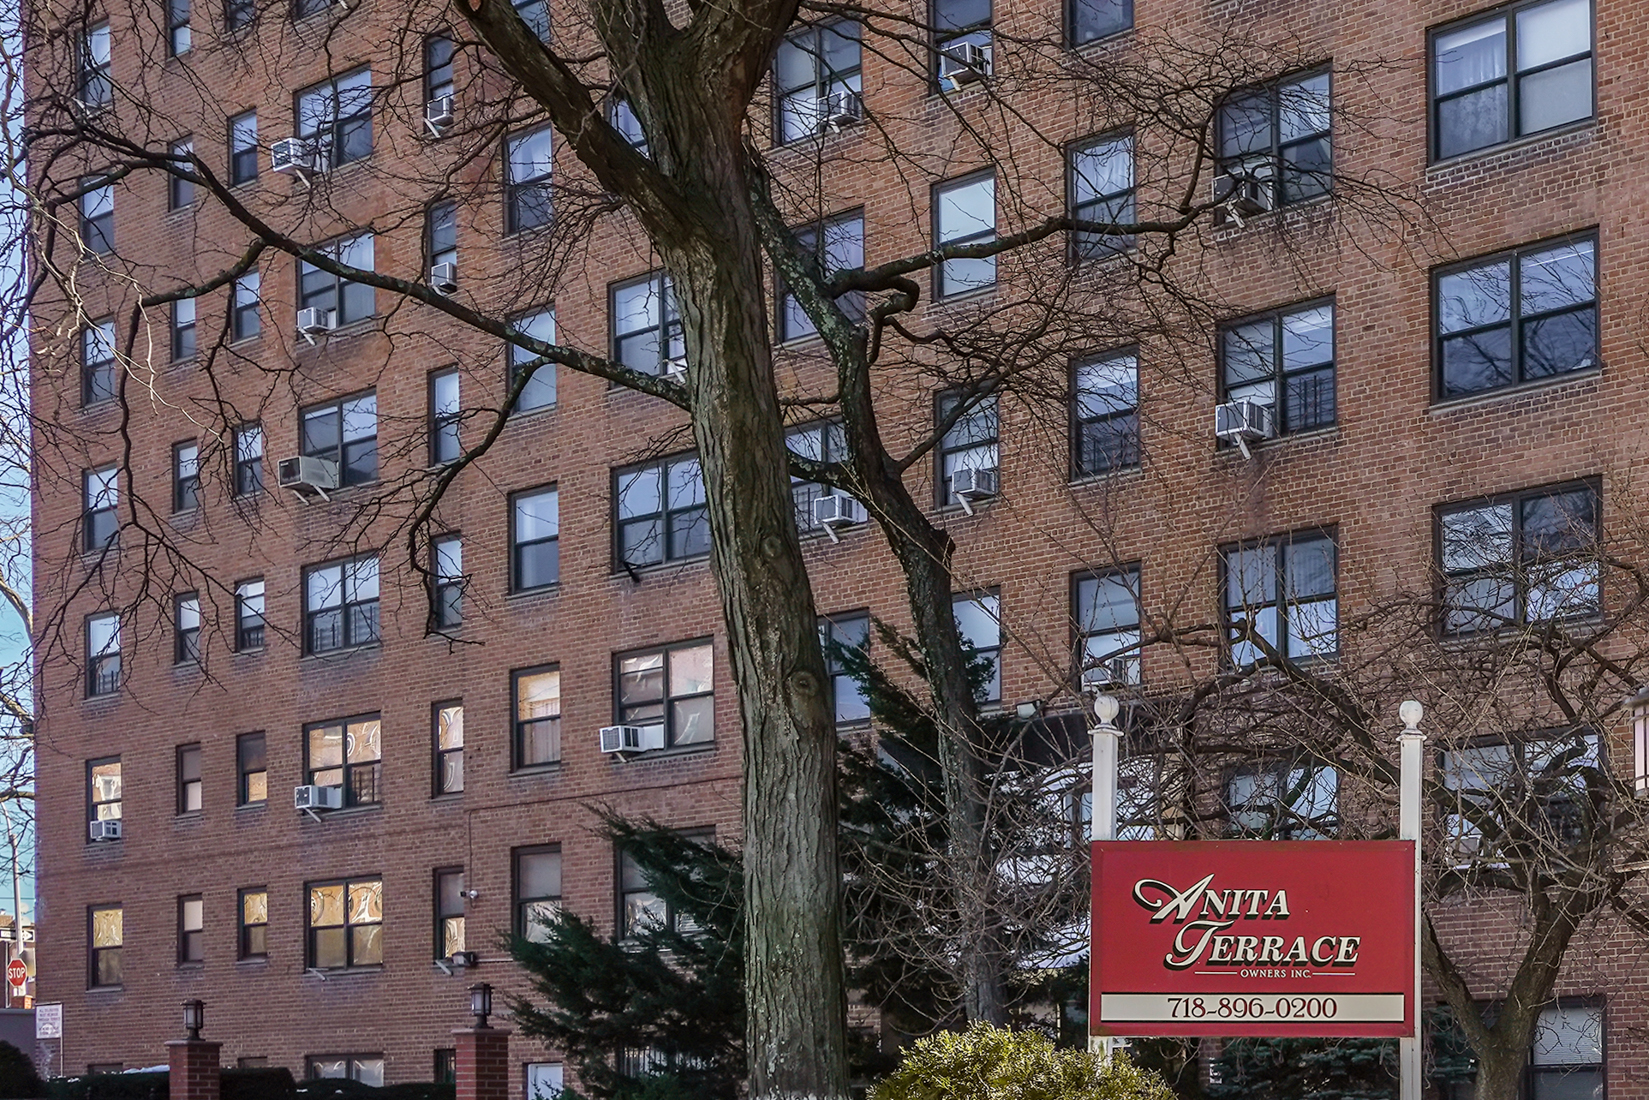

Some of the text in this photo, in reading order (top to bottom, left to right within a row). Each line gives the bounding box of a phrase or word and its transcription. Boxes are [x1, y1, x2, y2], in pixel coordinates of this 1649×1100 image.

[1132, 873, 1290, 924] ANITA
[1163, 919, 1361, 970] TERRACE
[8, 968, 26, 979] STOP
[1240, 969, 1286, 978] OWNERS
[1167, 997, 1338, 1019] 718-896-0200
